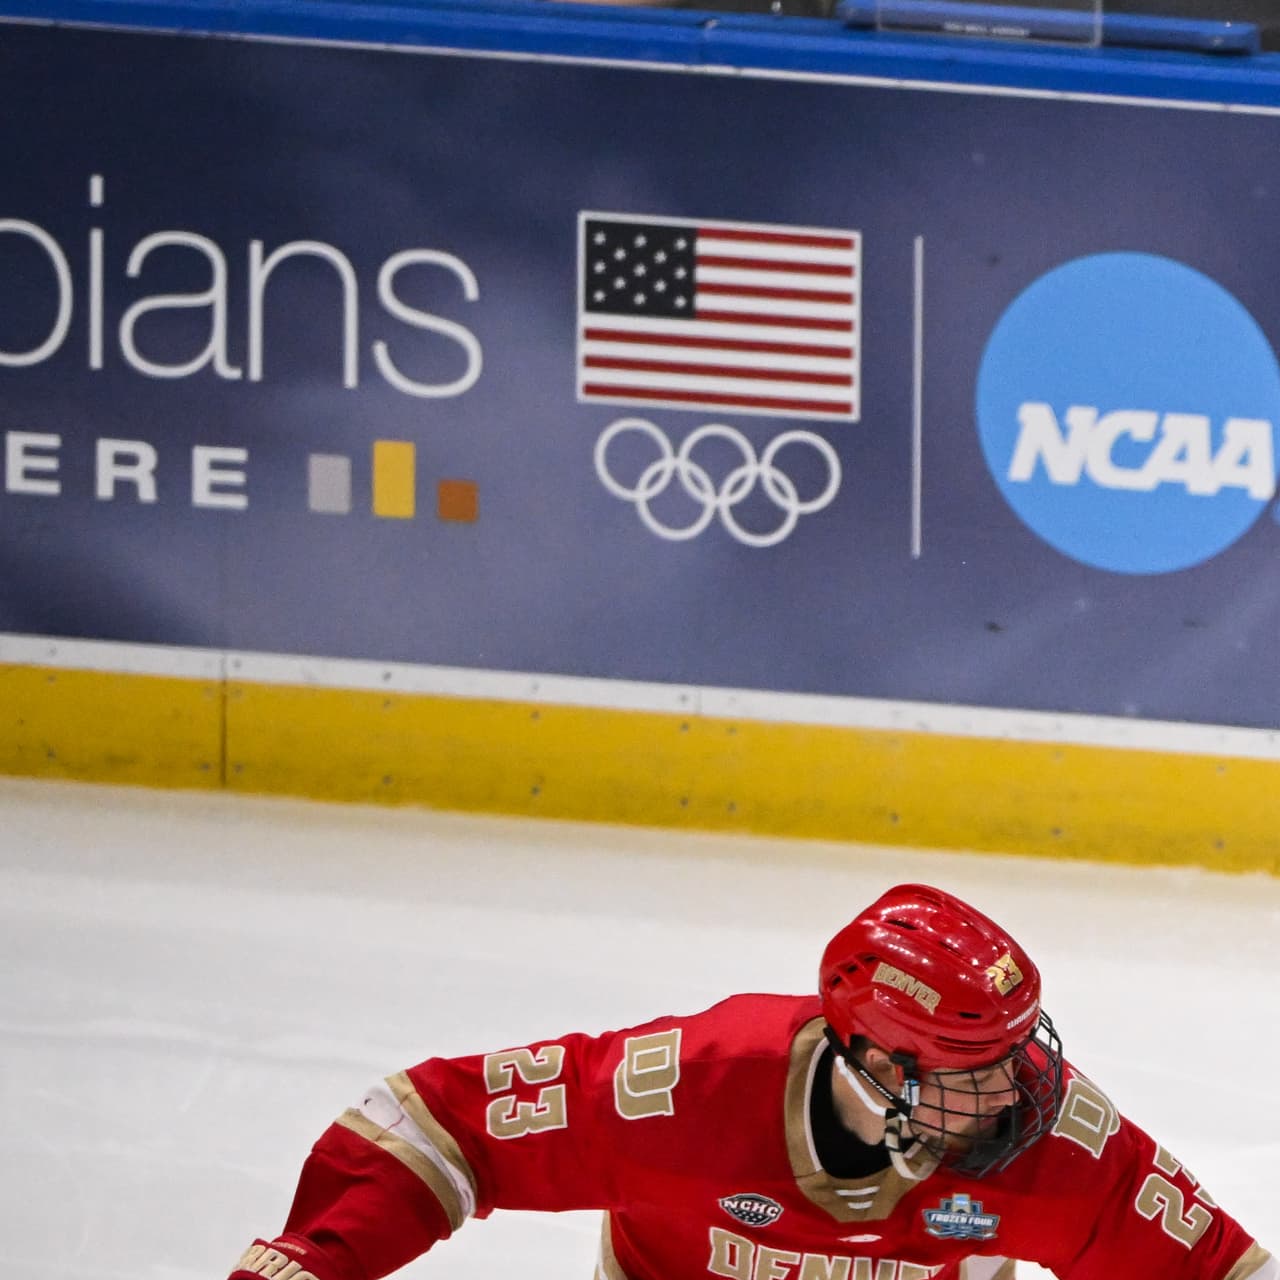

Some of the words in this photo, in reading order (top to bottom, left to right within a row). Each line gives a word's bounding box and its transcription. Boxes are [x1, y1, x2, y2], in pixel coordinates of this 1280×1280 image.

[1007, 401, 1276, 501] NCAA
[871, 961, 942, 1016] DENVER
[984, 953, 1024, 997] 23
[483, 1044, 568, 1140] 23
[723, 1199, 779, 1218] NCHC
[930, 1213, 968, 1225] FROZEN
[967, 1216, 994, 1228] FOUR
